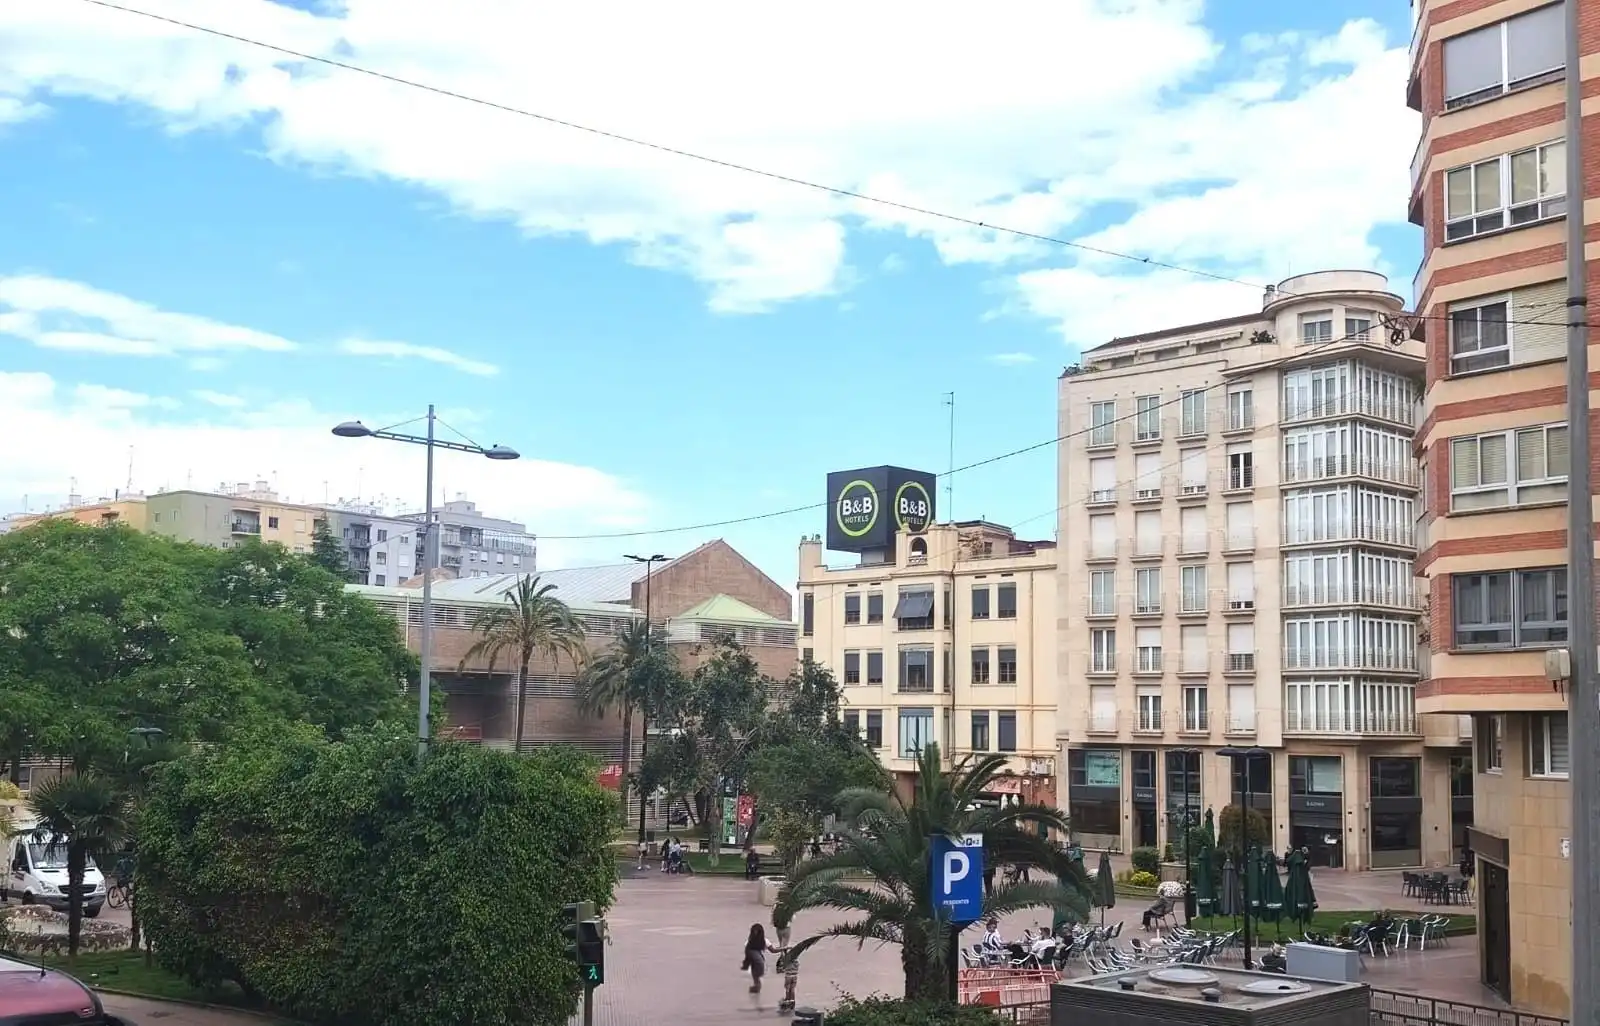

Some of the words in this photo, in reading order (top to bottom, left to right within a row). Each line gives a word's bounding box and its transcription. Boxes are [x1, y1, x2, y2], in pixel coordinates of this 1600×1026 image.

[842, 497, 873, 516] B&B
[900, 497, 927, 517] B&B
[845, 514, 870, 524] HOTELS
[902, 515, 924, 525] HOTELS
[943, 851, 970, 895] P
